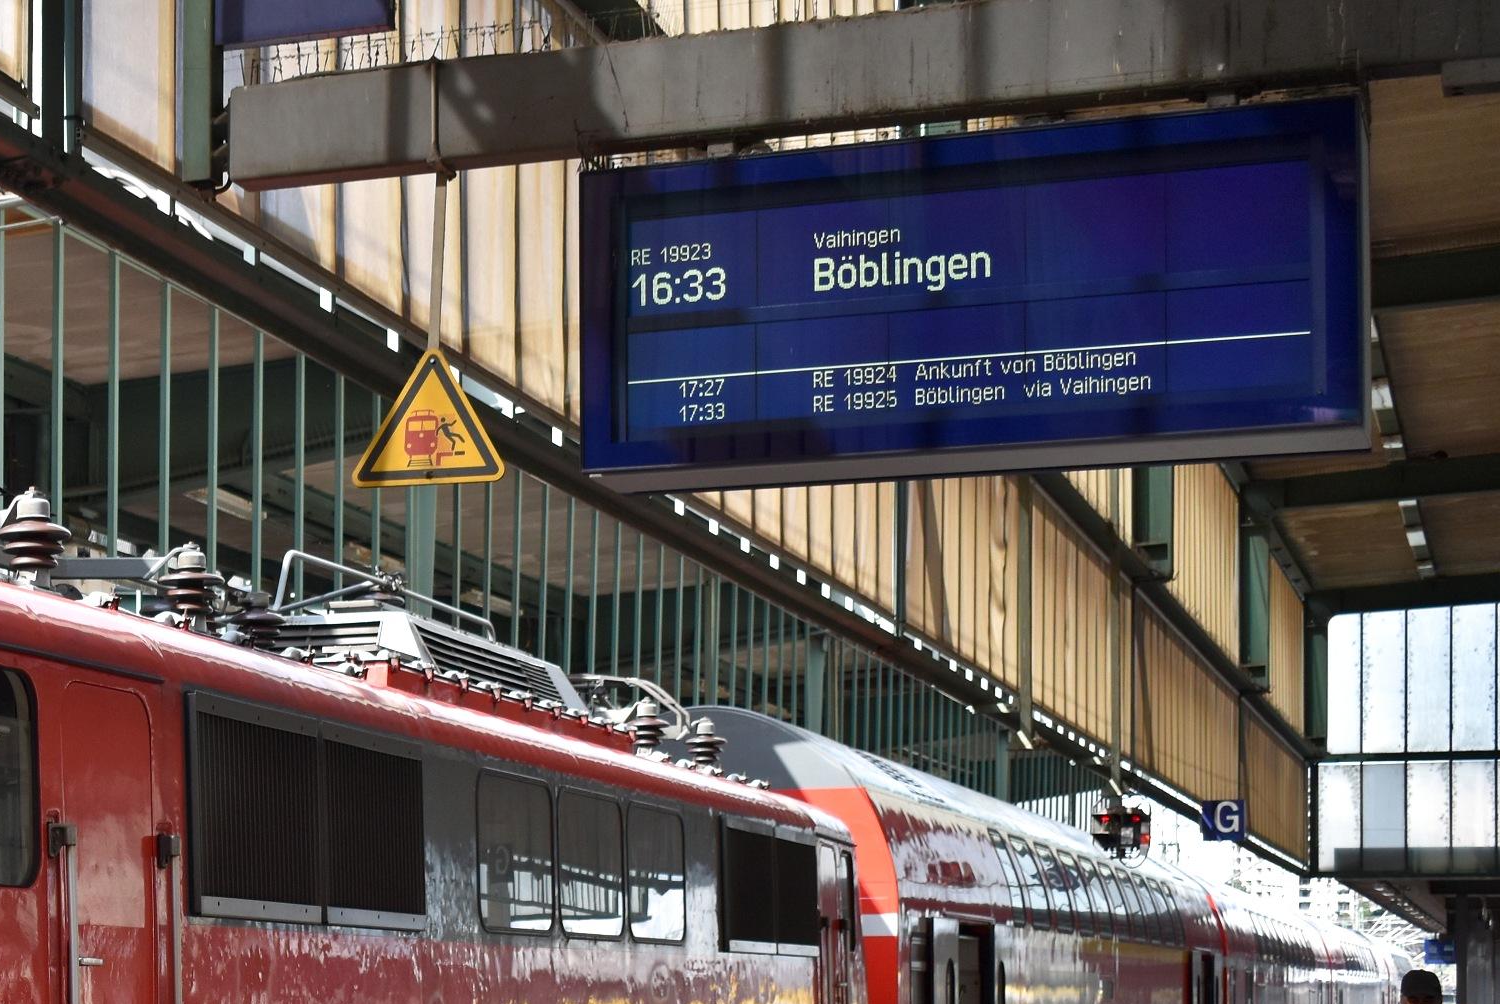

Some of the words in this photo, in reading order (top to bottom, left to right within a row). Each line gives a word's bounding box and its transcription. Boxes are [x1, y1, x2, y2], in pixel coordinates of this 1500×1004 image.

[631, 248, 651, 267] RE
[660, 242, 712, 263] 19923
[813, 228, 900, 249] Vaihingen
[631, 266, 726, 307] 16:33
[813, 251, 991, 292] Böblingen
[678, 379, 725, 398] 17:27
[812, 370, 834, 388] RE
[843, 366, 897, 386] 19924
[915, 358, 992, 381] Ankunft
[1000, 358, 1035, 375] von
[1043, 351, 1137, 372] Böblingen
[678, 402, 725, 422] 17:33
[812, 395, 835, 413] RE
[843, 390, 898, 411] 19925
[915, 384, 1005, 406] Böblingen
[1023, 380, 1052, 398] via
[1060, 374, 1152, 396] Vaihingen
[1214, 801, 1241, 834] G
